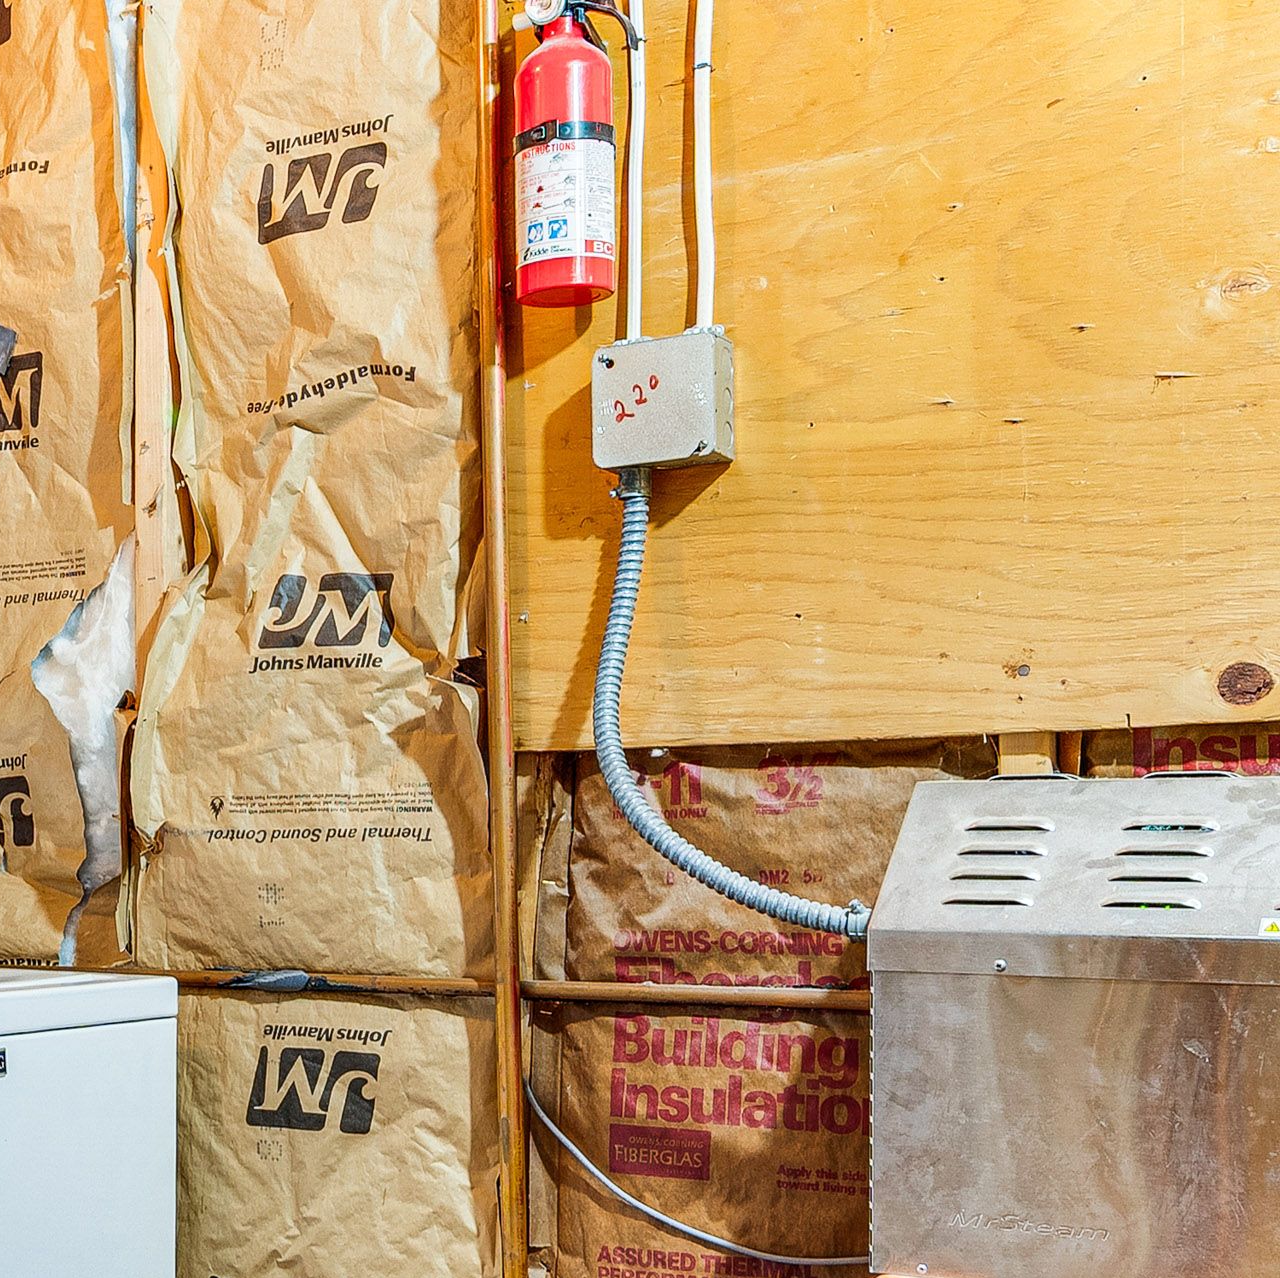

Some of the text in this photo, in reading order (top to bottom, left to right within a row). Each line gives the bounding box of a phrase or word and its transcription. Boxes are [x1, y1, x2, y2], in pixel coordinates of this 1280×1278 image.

[266, 115, 394, 155] Johns Manville
[258, 142, 387, 244] JM
[614, 374, 660, 423] 220
[5, 593, 28, 604] and
[33, 589, 85, 605] Thermal
[258, 572, 395, 649] JM
[249, 653, 383, 674] Johns Manville
[208, 827, 432, 843] Thermal and Sound Control
[614, 929, 844, 957] OWENS-CORNING
[263, 1024, 392, 1046] Johns Manville
[612, 1012, 860, 1089] Building
[246, 1046, 381, 1134] JM
[609, 1067, 870, 1136] Insulatio
[614, 1145, 703, 1169] FIBERGLAS
[777, 1165, 867, 1182] Apply this side
[777, 1180, 856, 1196] toward living
[948, 1208, 1111, 1241] MrSteam
[598, 1246, 696, 1272] ASSURED
